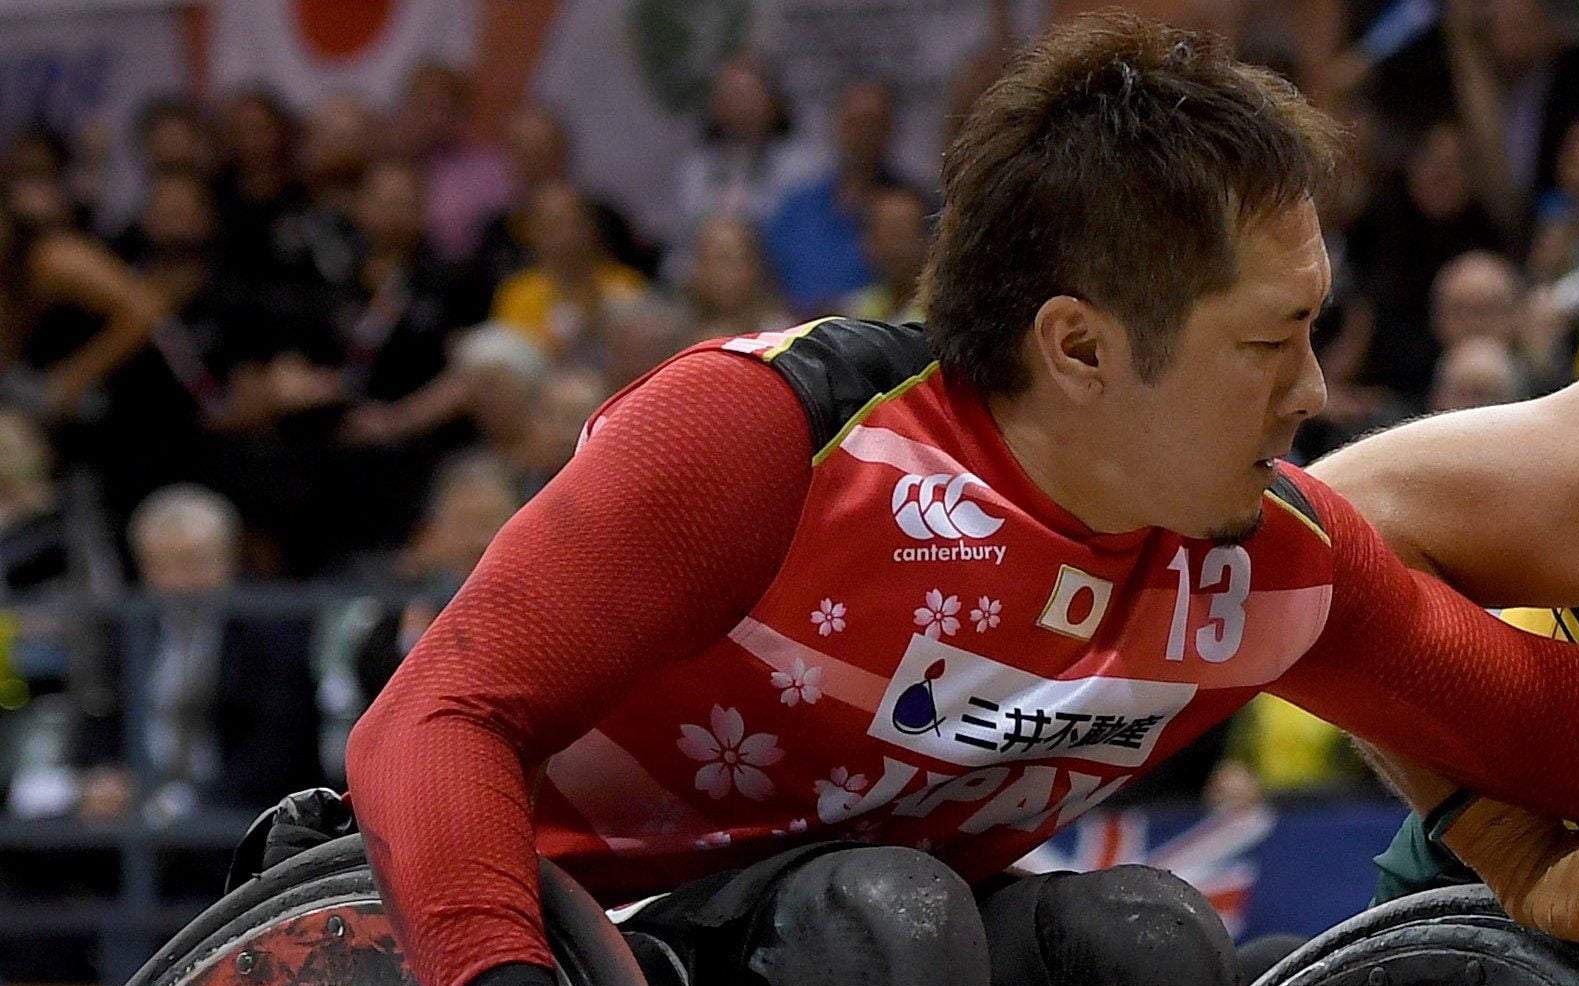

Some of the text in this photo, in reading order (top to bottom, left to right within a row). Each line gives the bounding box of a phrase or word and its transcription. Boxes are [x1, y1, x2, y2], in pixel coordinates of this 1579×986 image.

[893, 539, 1007, 565] canterbury
[1164, 545, 1252, 663] 13
[955, 696, 1164, 753] 三井不動産
